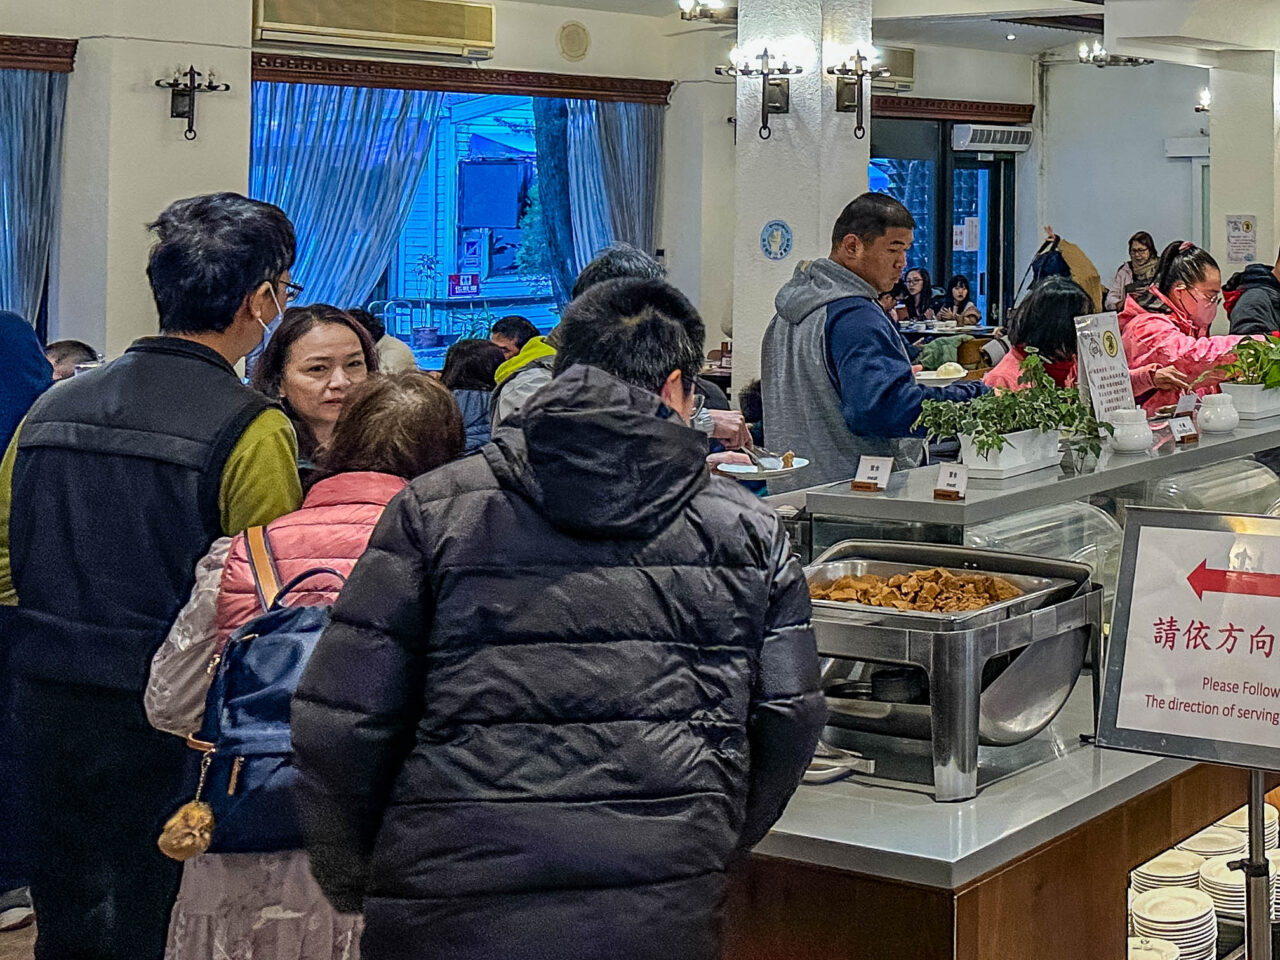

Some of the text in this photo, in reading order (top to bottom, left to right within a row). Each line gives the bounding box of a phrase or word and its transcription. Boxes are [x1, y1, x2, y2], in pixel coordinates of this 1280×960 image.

[1202, 676, 1280, 698] Please Follow
[1145, 694, 1165, 709] The
[1168, 697, 1219, 716] direction
[1222, 704, 1236, 717] of
[1237, 707, 1280, 726] serving
